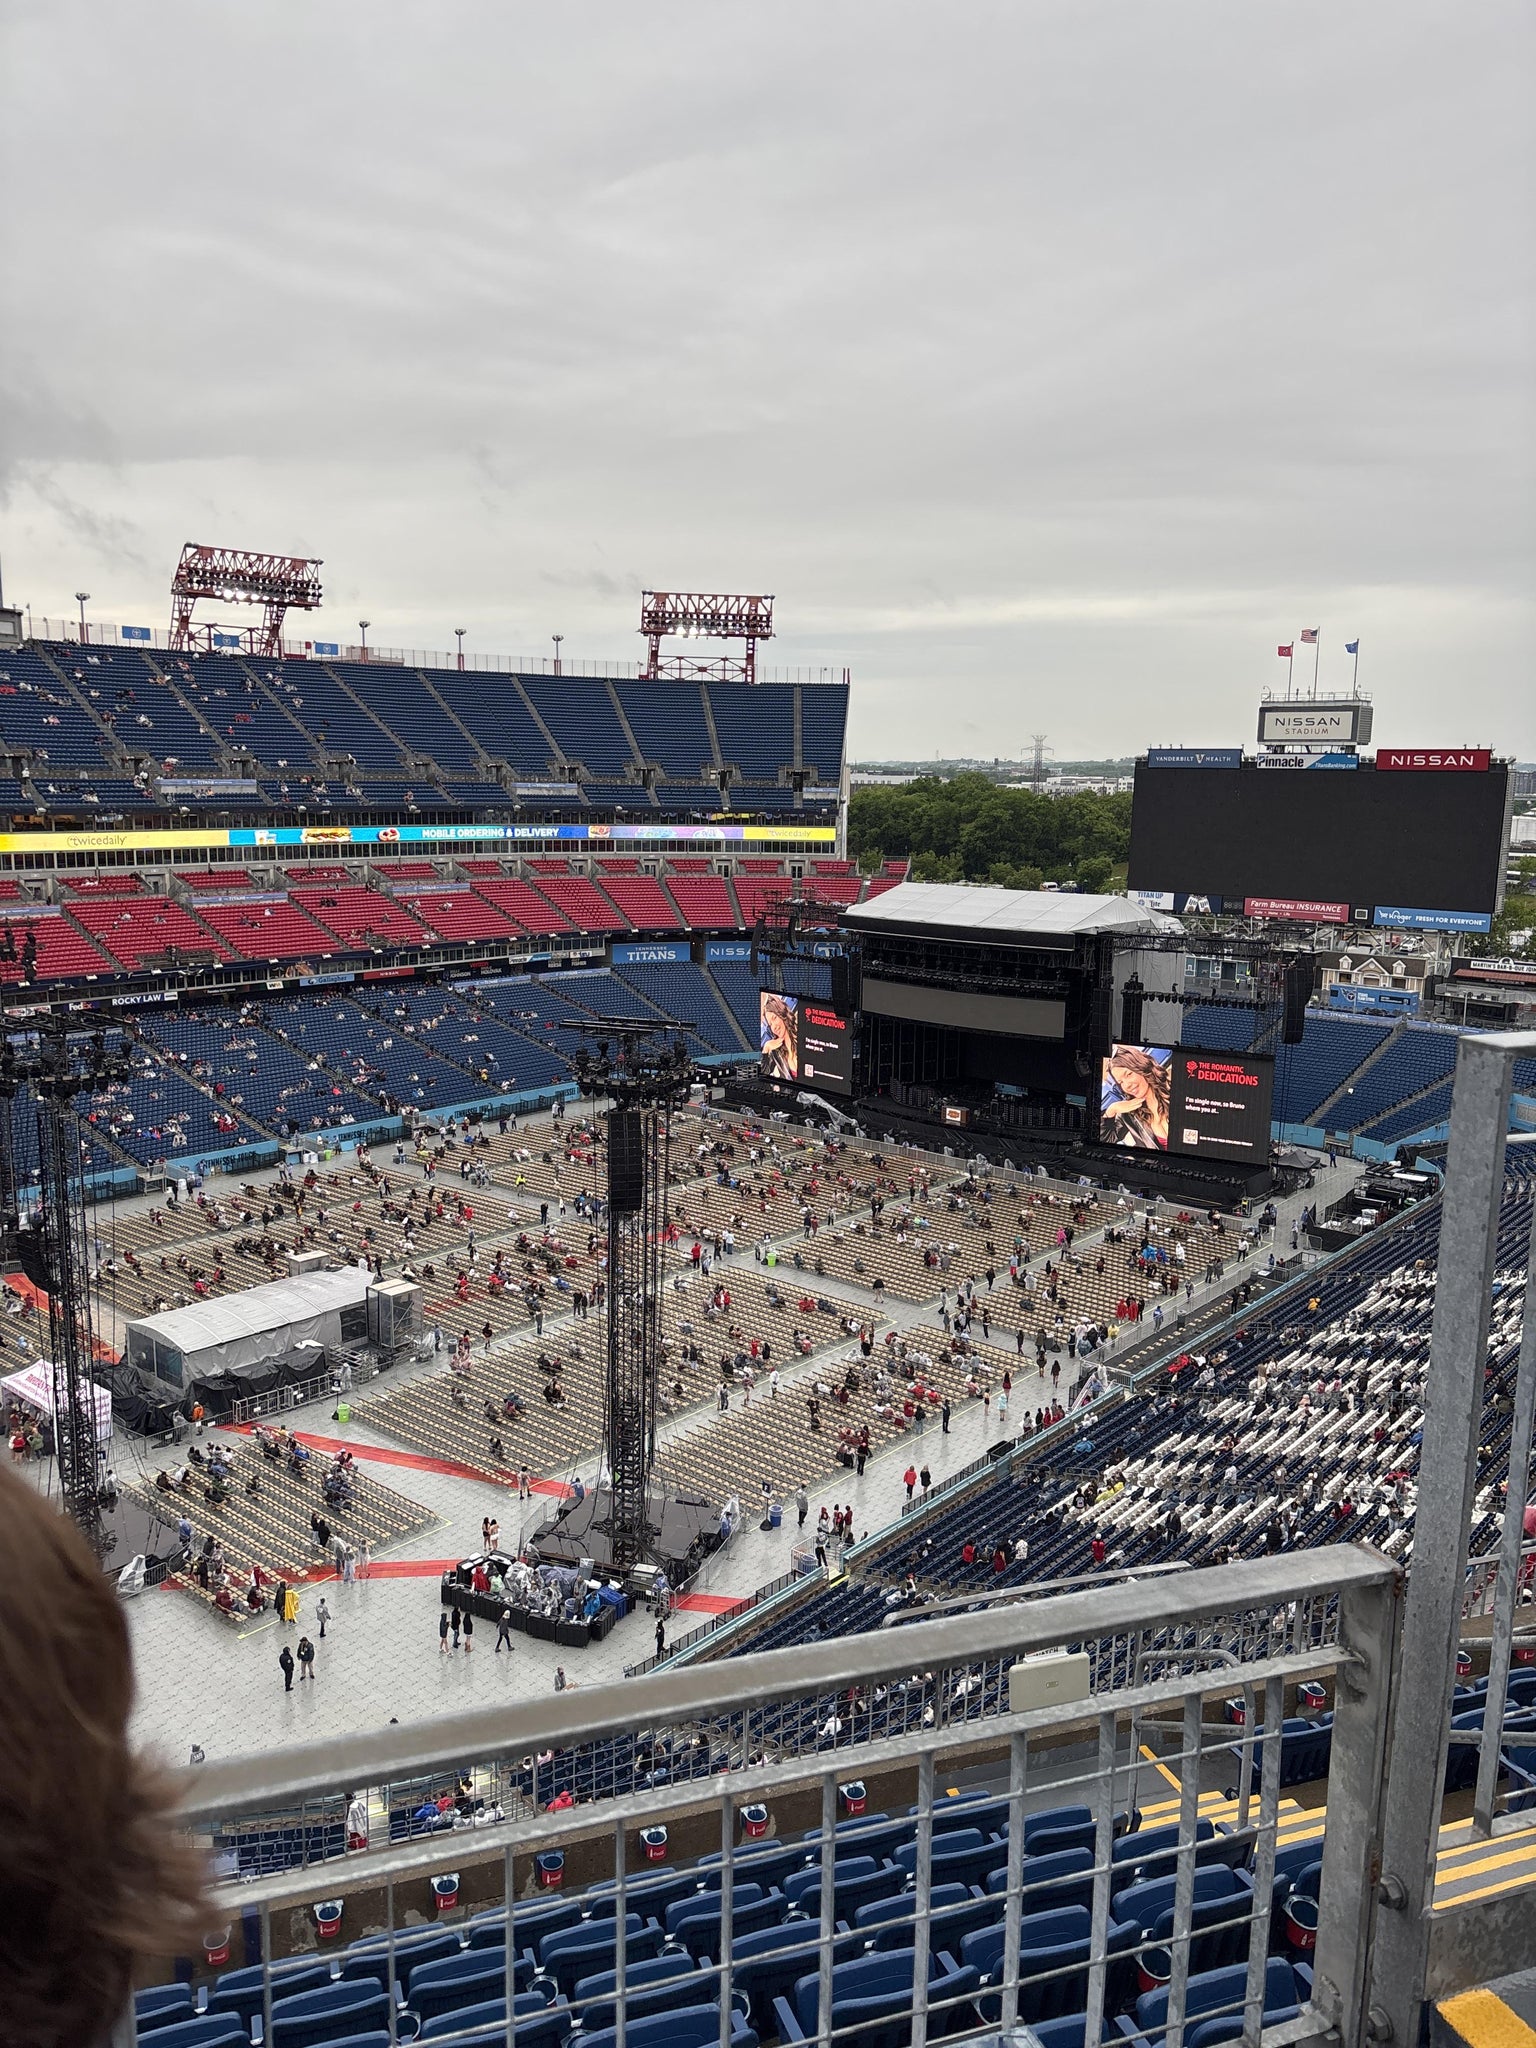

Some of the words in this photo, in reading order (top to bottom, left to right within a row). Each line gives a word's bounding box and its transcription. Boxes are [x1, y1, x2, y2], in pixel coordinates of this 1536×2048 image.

[1275, 717, 1341, 727] NISSAN
[1258, 756, 1304, 768] Pinnacle
[1390, 755, 1474, 766] NISSAN
[422, 828, 456, 838] MOBILE
[457, 828, 505, 838] ORDERING
[505, 828, 513, 837] &
[514, 827, 560, 837] DELIVERY
[72, 835, 127, 846] twicedaily
[1137, 891, 1155, 899] TITAN
[1250, 900, 1269, 908] Farm
[1269, 901, 1295, 910] Bureau
[1296, 903, 1343, 913] INSURANCE
[1388, 910, 1412, 924] Kroger
[626, 950, 676, 961] TITANS
[111, 996, 142, 1006] ROCKY
[142, 994, 161, 1003] LAW
[68, 1001, 93, 1011] FedEx
[811, 1015, 846, 1029] DEDICATIONS
[1198, 1061, 1210, 1070] THE
[1211, 1063, 1244, 1074] ROMANTIC
[1197, 1070, 1259, 1086] DEDICATIONS
[1194, 1098, 1210, 1106] single
